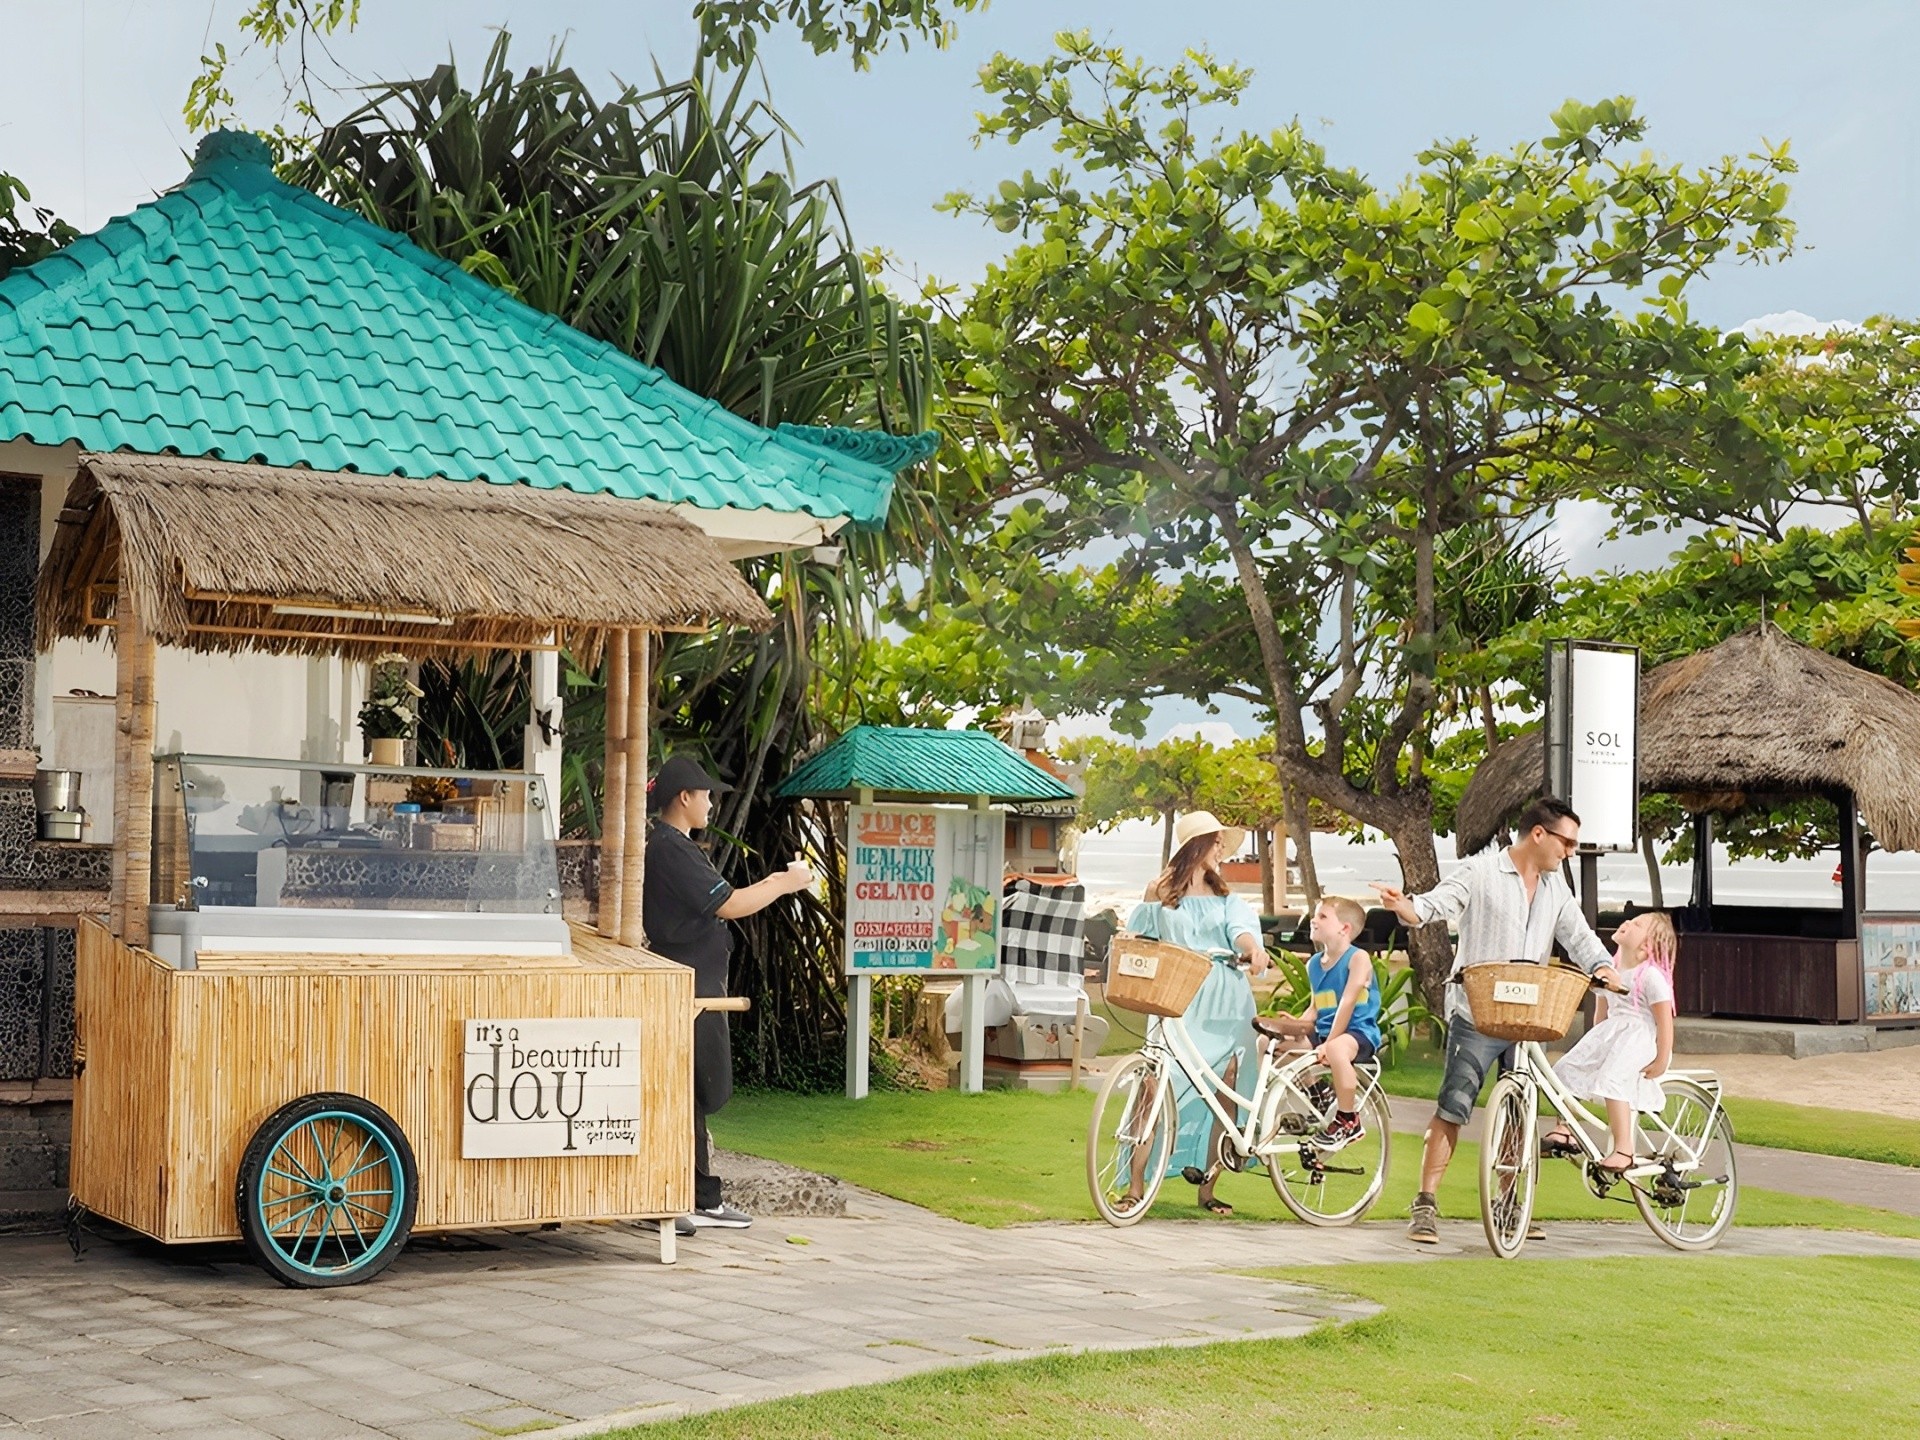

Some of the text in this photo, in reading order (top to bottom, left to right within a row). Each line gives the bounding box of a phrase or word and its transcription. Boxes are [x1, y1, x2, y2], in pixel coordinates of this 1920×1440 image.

[1586, 731, 1621, 748] SOL
[857, 811, 936, 834] JUICE
[856, 847, 935, 867] HEALTHY
[880, 866, 935, 883] FRESH
[856, 882, 935, 901] GELATO
[476, 1022, 519, 1042] it's a
[511, 1041, 621, 1069] beautiful
[467, 1043, 588, 1151] day
